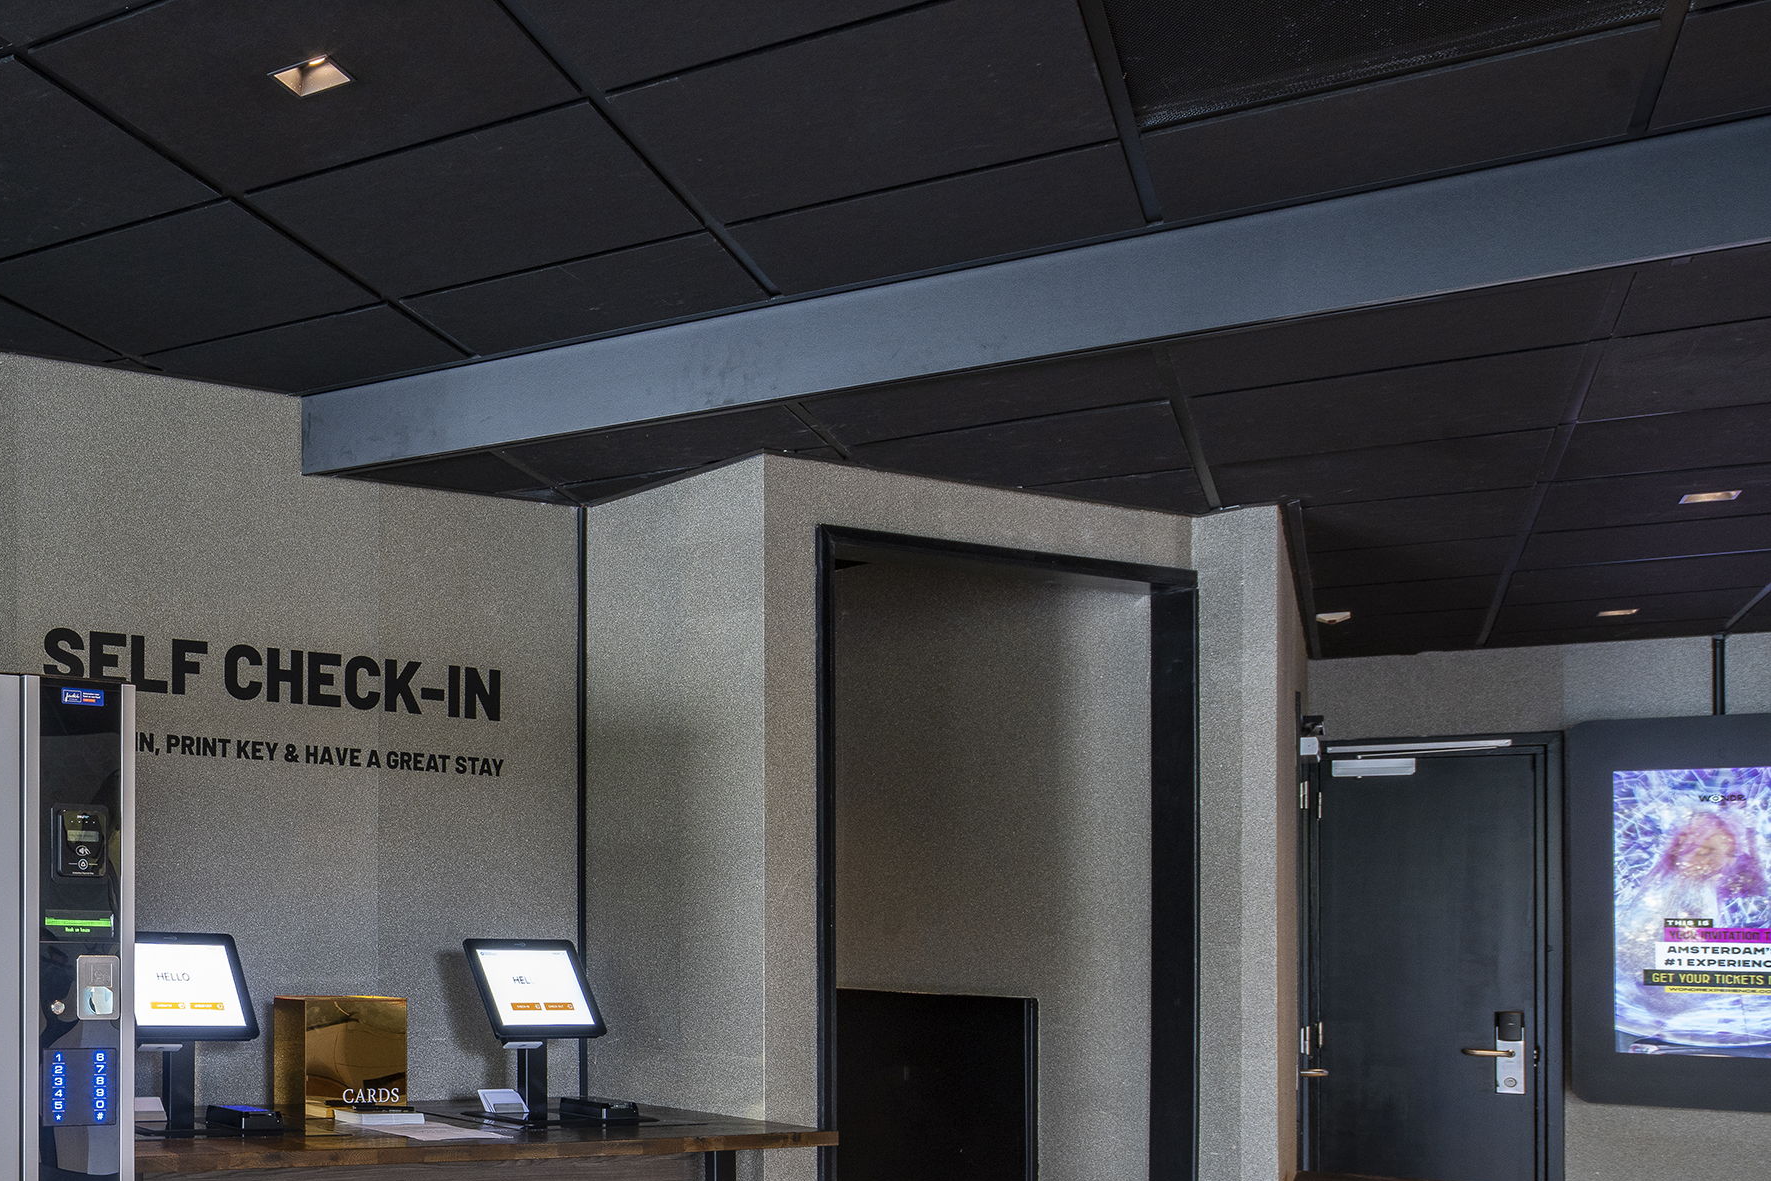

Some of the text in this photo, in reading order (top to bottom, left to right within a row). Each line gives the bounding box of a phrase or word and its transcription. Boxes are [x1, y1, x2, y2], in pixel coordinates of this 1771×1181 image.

[43, 627, 501, 722] SELF CHECK-IN
[166, 734, 231, 758] PRINT
[236, 739, 279, 761] KEY
[284, 743, 299, 763] &
[305, 745, 362, 767] HAVE
[366, 749, 382, 768] A
[386, 751, 451, 773] GREAT
[455, 755, 504, 776] STAY
[1669, 931, 1771, 940] YOUR INVITATION T
[1667, 946, 1771, 955] AMSTERDAM'
[1665, 958, 1682, 966] #1
[156, 972, 190, 982] HELLO
[512, 975, 534, 984] HEL
[1652, 973, 1765, 985] GET YOUR TICKETS
[343, 1087, 400, 1104] CARDS
